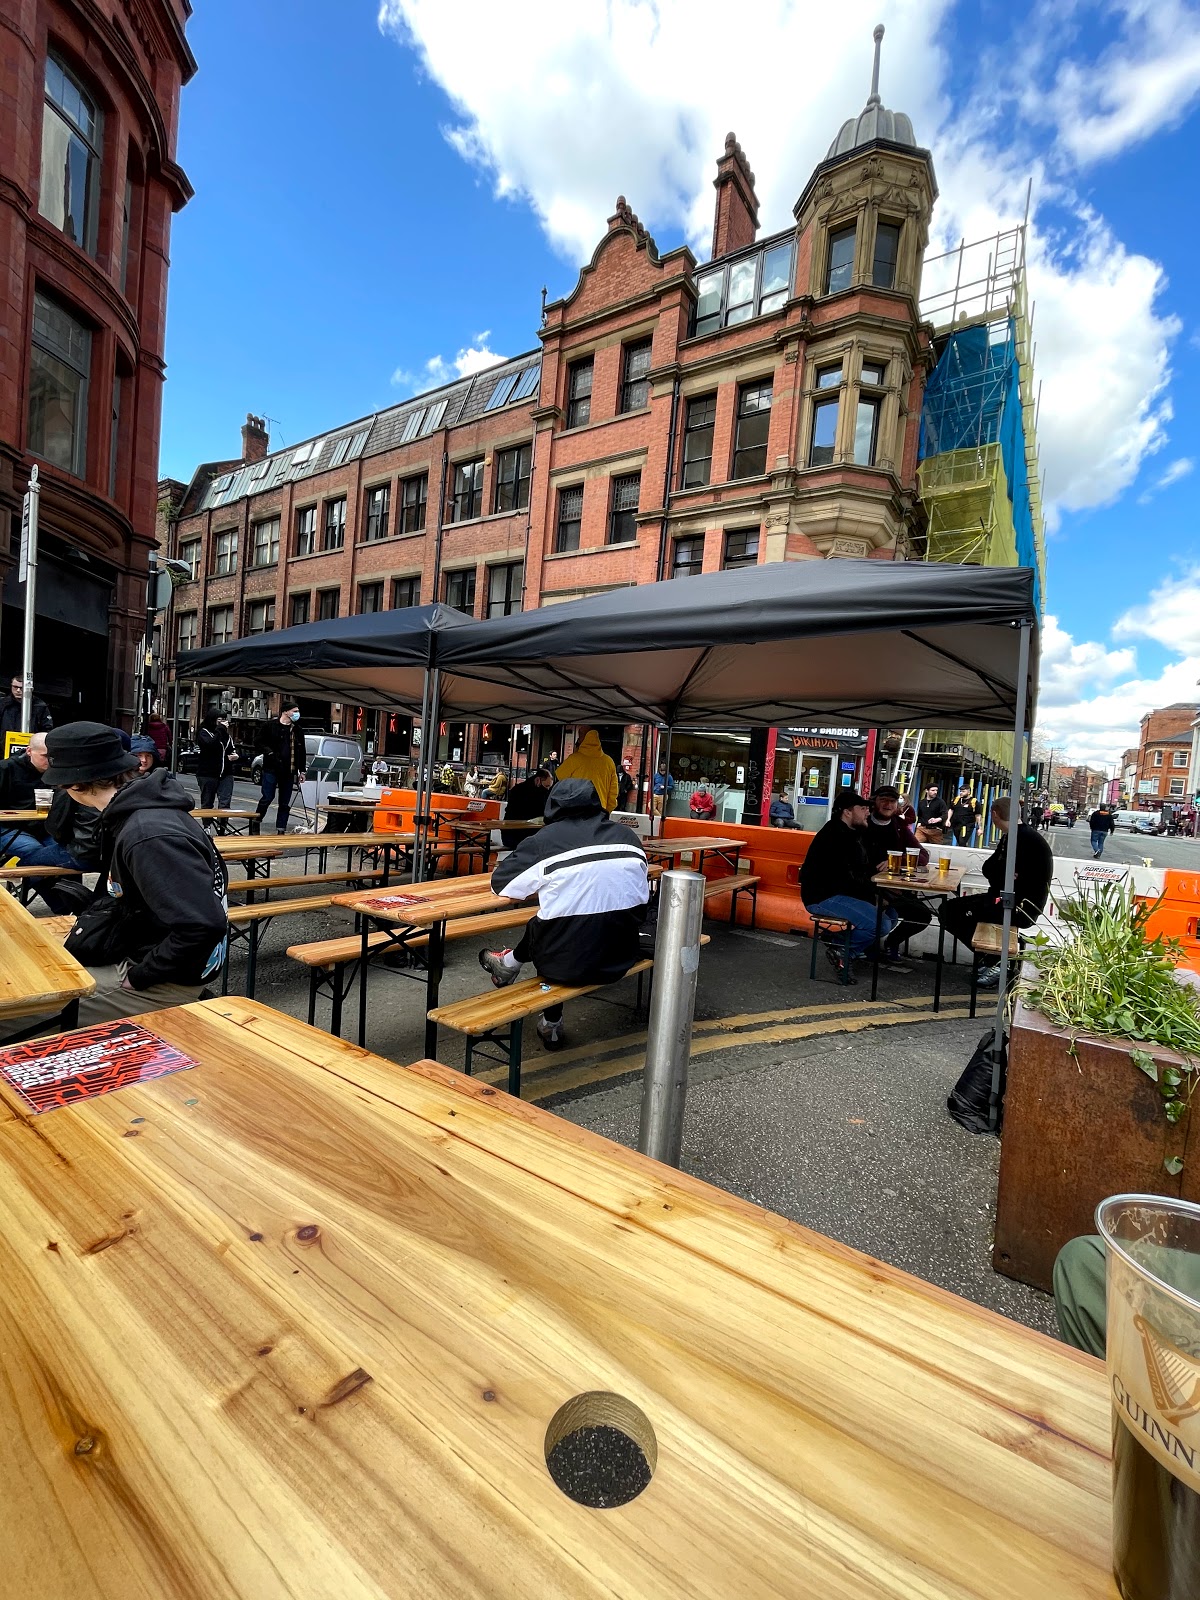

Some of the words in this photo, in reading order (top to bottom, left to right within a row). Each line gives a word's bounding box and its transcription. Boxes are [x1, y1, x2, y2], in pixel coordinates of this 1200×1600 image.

[791, 735, 839, 750] BIRTHDAY
[1083, 866, 1116, 874] BORDER
[1084, 871, 1121, 880] BARRIERS
